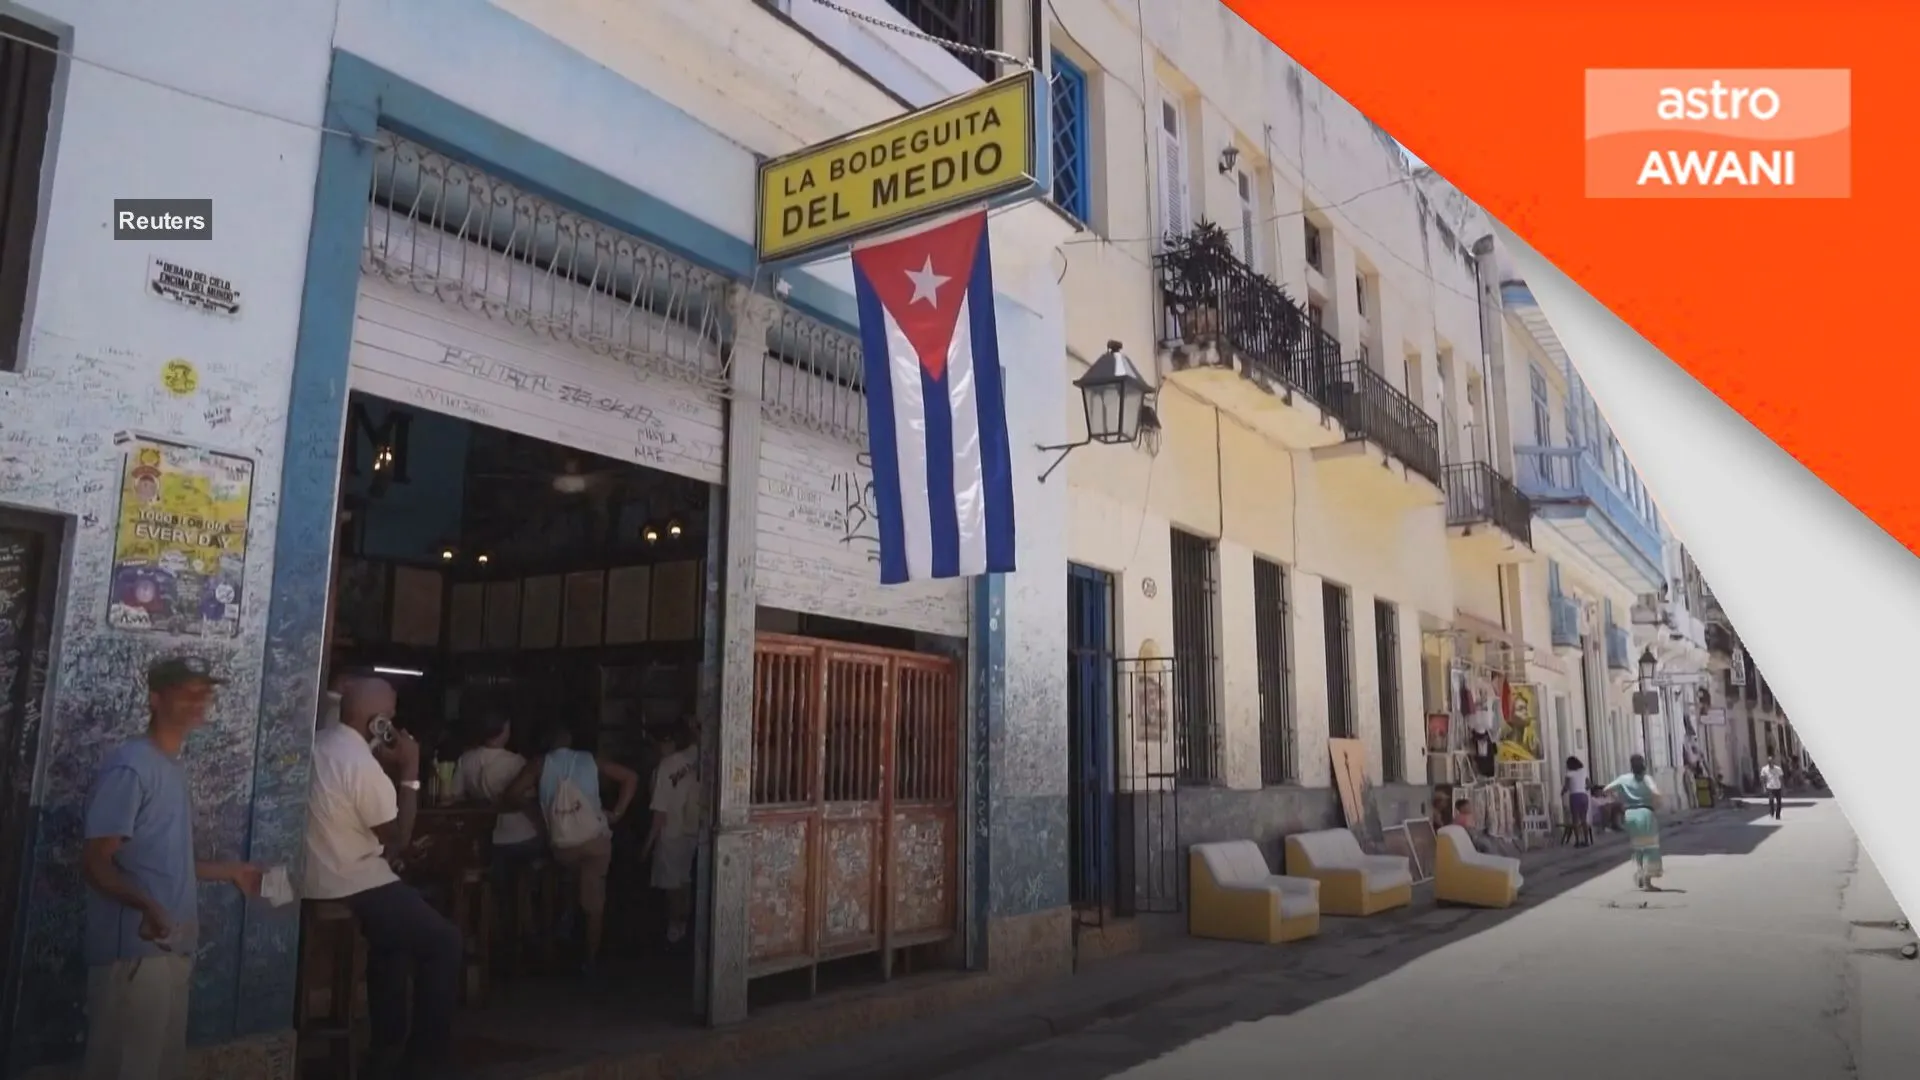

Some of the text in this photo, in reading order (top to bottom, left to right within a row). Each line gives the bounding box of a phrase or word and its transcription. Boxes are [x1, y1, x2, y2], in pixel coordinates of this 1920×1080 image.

[784, 106, 1000, 197] LA BODEGUITA
[782, 142, 1002, 237] DEL MEDIO
[160, 271, 190, 291] ENCIMA
[191, 281, 205, 295] DEL
[194, 271, 207, 284] DEL
[135, 522, 194, 544] EVERY
